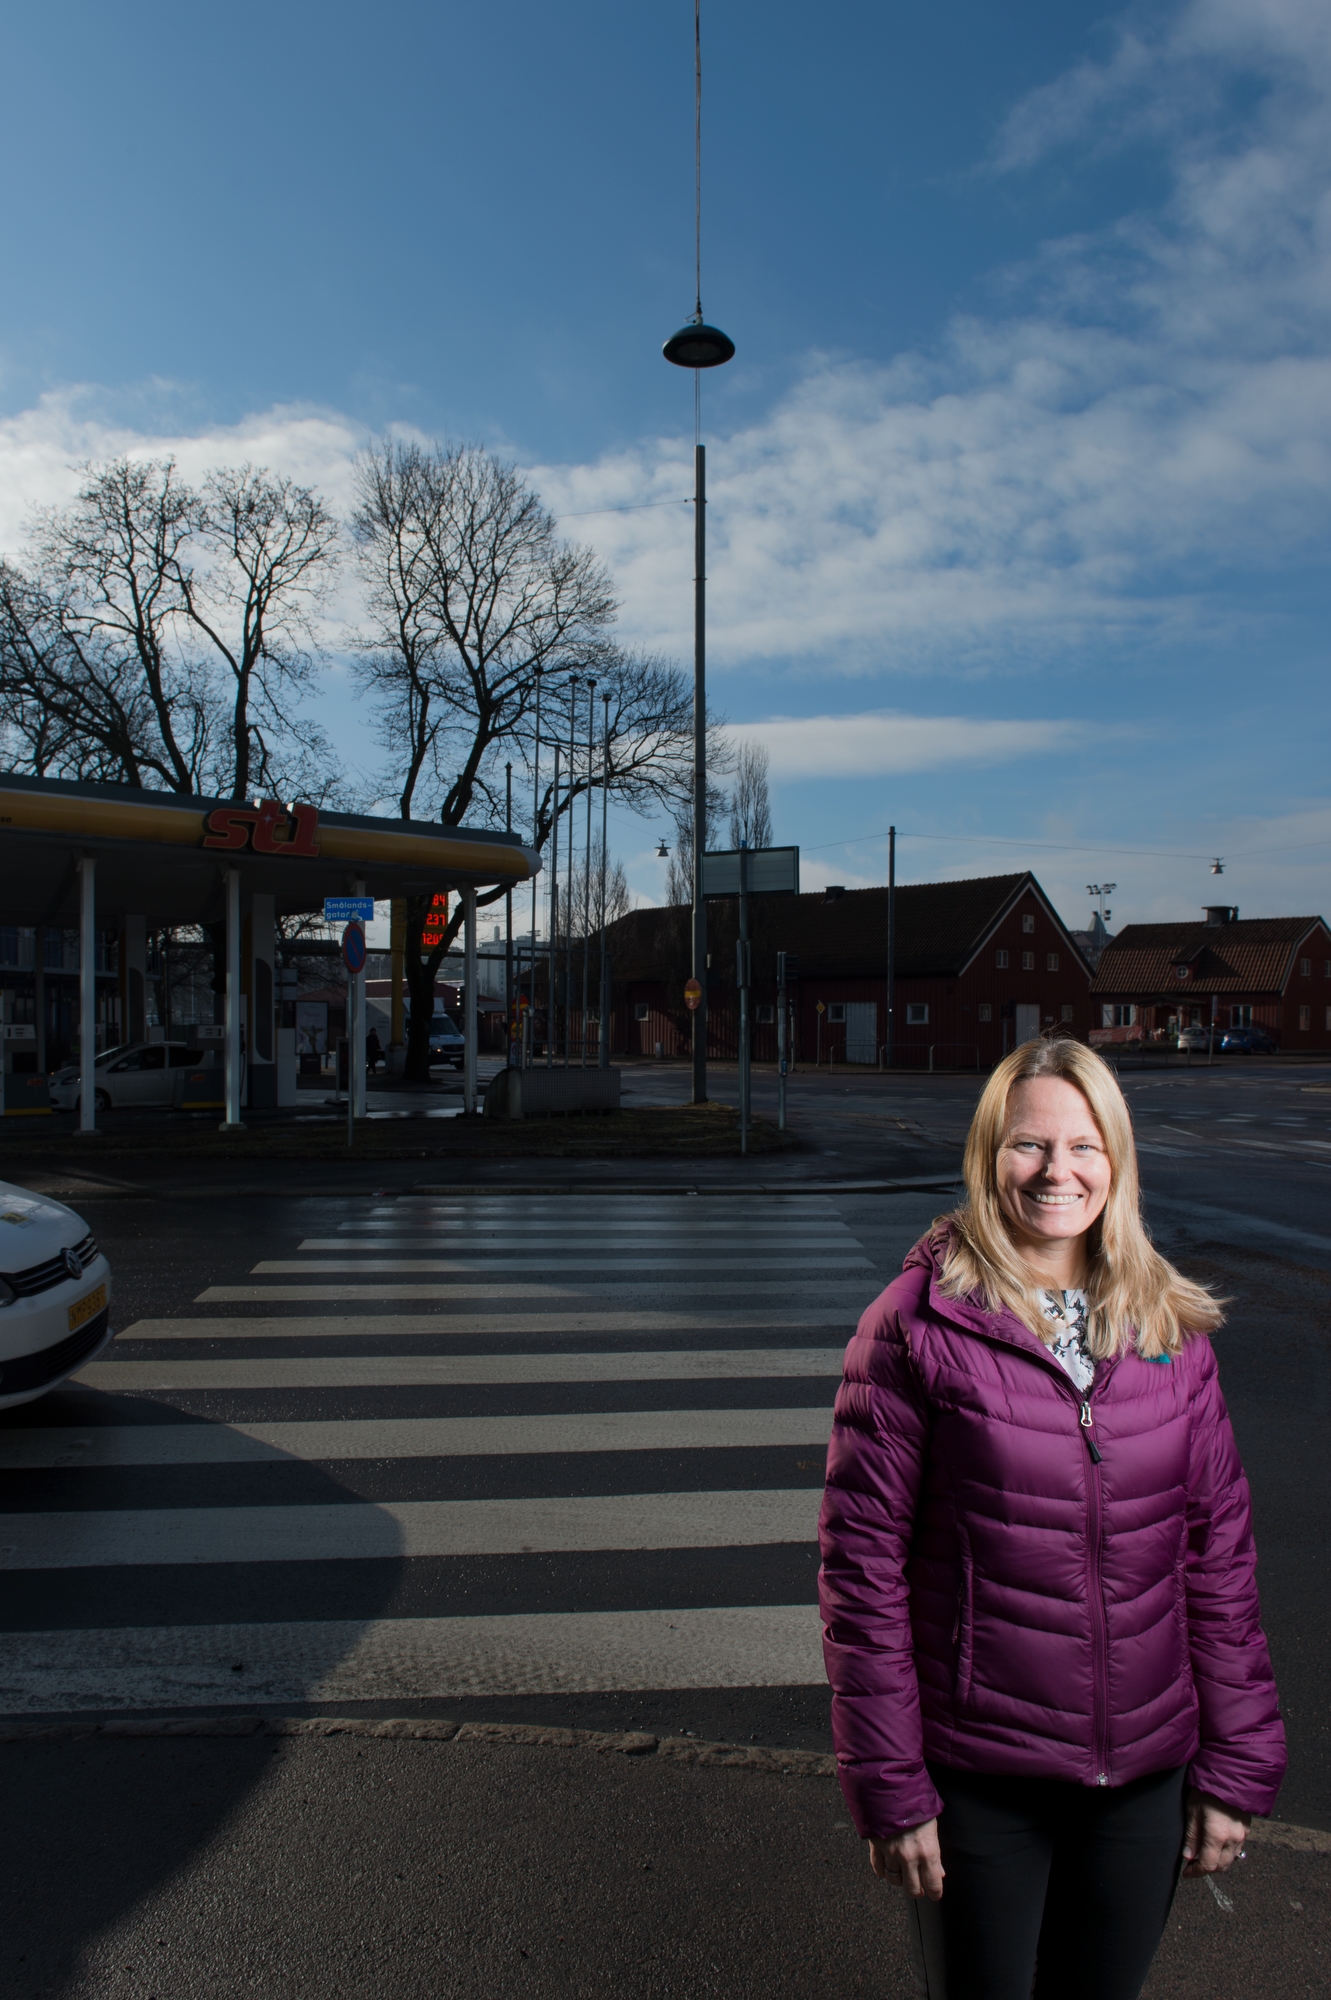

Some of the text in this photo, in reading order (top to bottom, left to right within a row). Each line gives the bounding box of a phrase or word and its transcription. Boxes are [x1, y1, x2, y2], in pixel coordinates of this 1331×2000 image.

[326, 901, 372, 909] Smålands-
[432, 894, 446, 906] .84
[426, 913, 446, 926] 2.37
